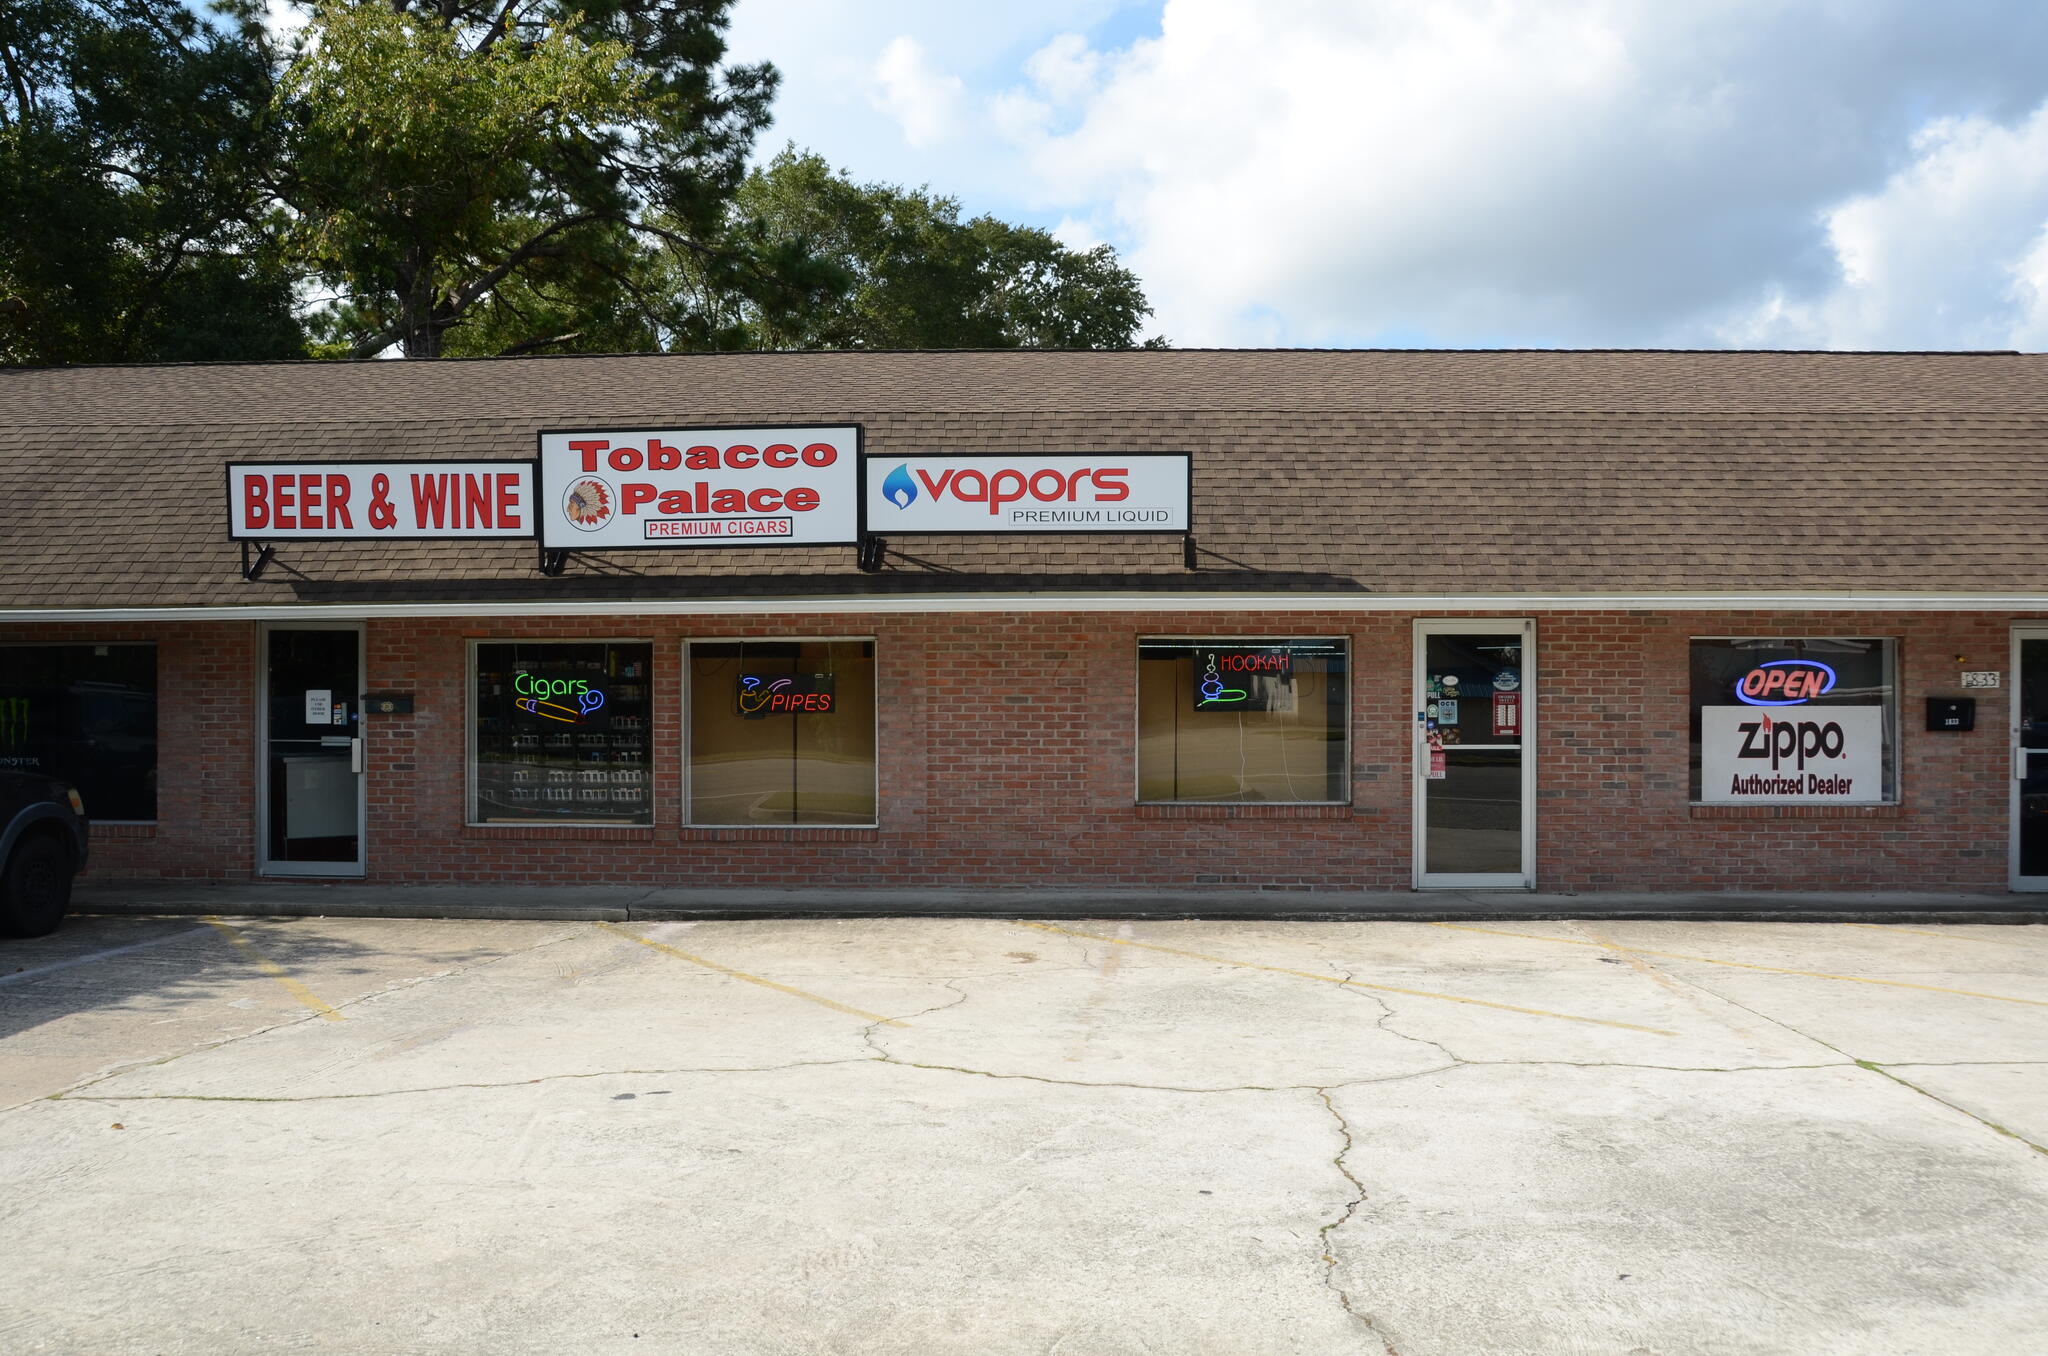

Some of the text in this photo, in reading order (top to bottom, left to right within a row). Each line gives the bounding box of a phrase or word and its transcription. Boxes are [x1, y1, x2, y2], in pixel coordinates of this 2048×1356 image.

[568, 438, 838, 472] Tobacco
[244, 473, 521, 530] BEER & WINE
[621, 482, 821, 515] Palace
[915, 468, 1130, 515] vapors
[649, 520, 788, 536] PREMIUM CIGARS
[1013, 510, 1168, 523] PREMIUM LIQUID
[1221, 655, 1289, 671] HOOKAH
[515, 673, 588, 700] Cigars
[1743, 668, 1825, 698] OPEN
[771, 694, 831, 711] PIPES
[1731, 773, 1852, 795] Authorized Dealer
